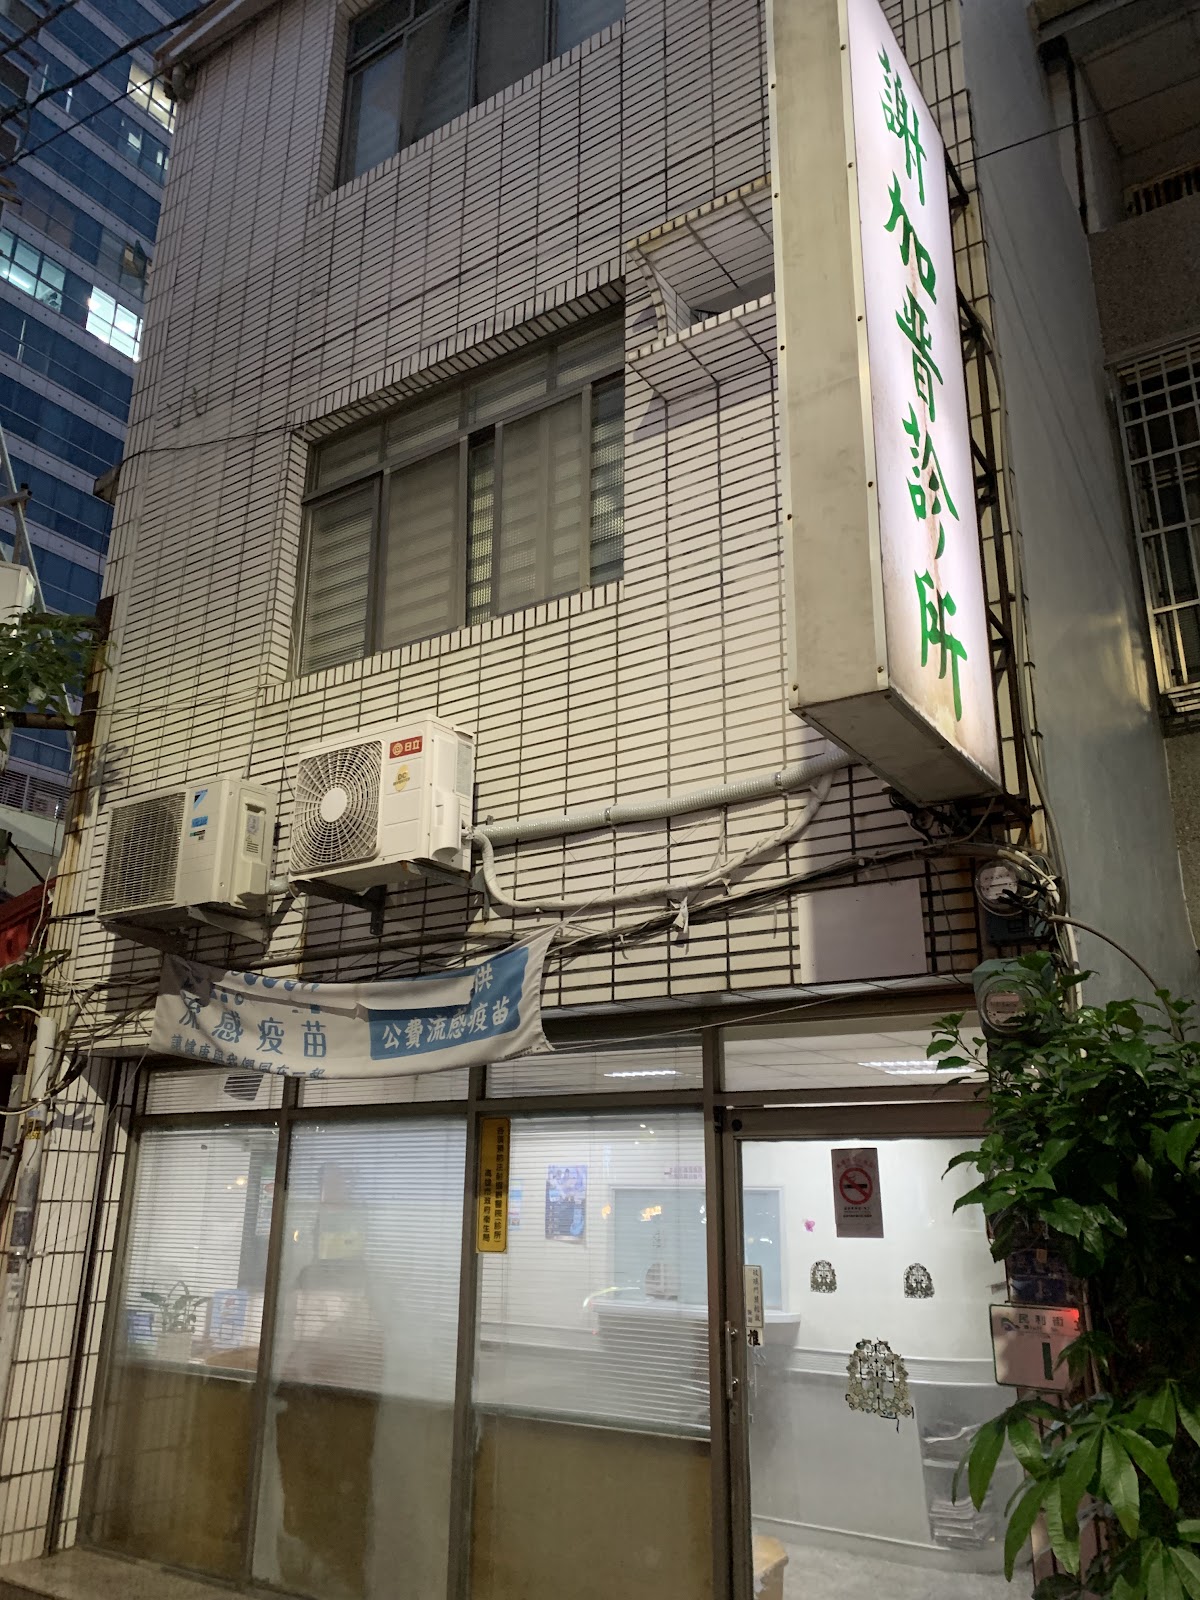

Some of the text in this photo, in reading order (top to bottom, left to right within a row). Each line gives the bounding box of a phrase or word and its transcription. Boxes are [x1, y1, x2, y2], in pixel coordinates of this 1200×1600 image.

[404, 739, 420, 752] 日立
[397, 772, 407, 781] DC
[382, 995, 510, 1050] 公費流感疫苗
[1018, 1313, 1064, 1327] 民利街
[747, 1329, 761, 1347] 推
